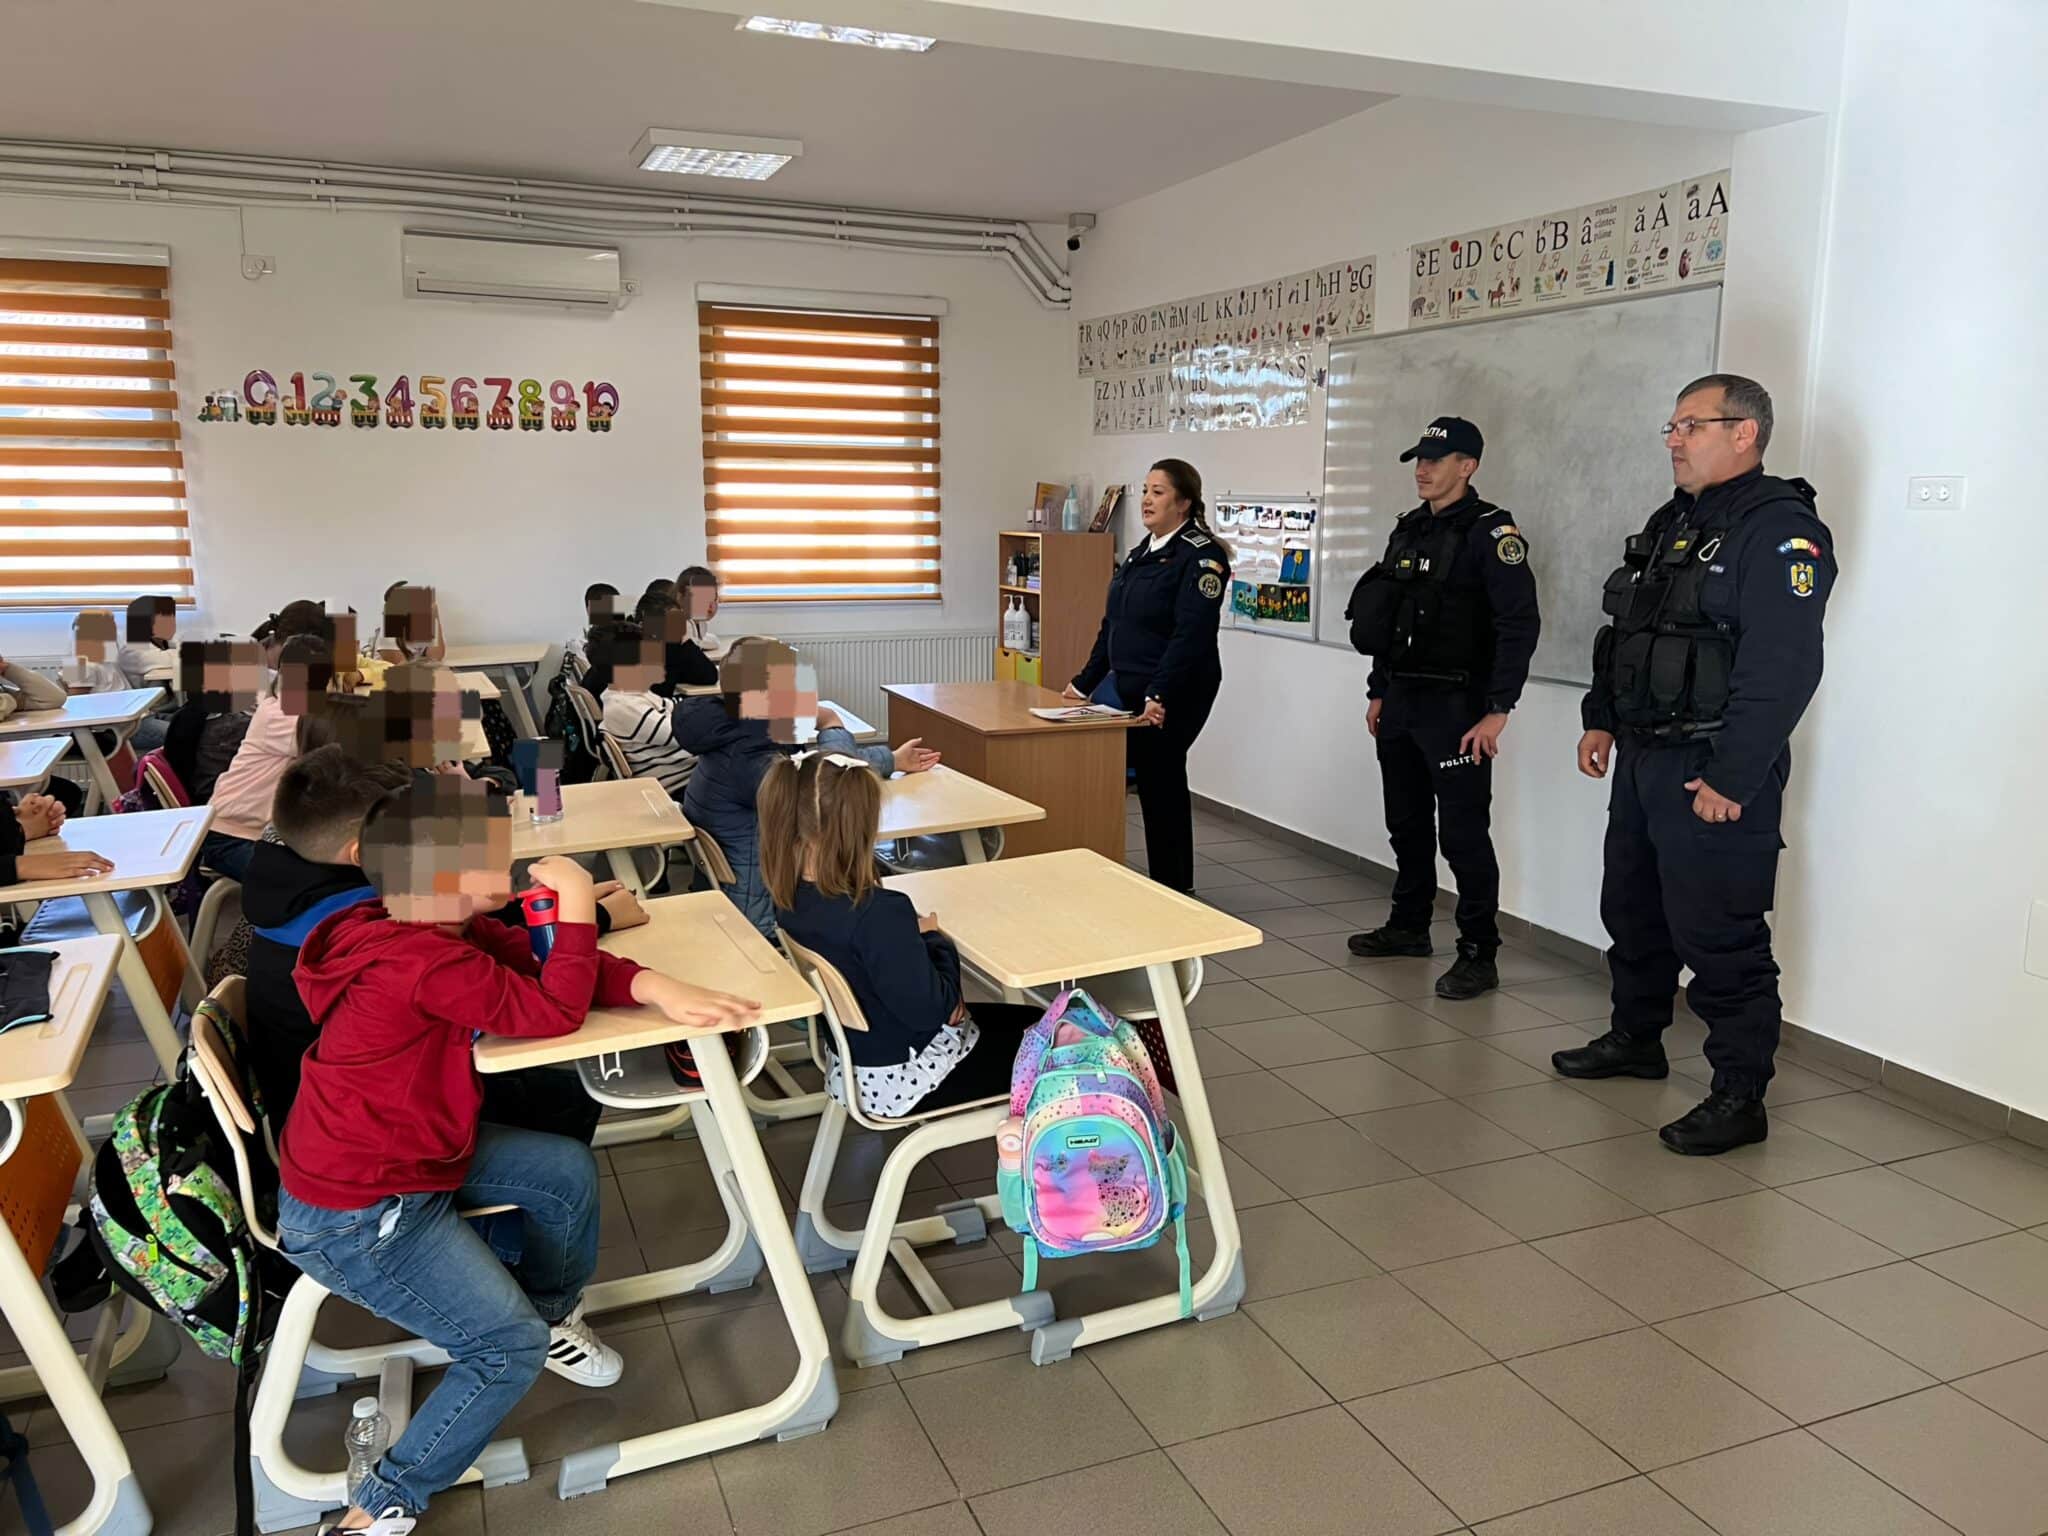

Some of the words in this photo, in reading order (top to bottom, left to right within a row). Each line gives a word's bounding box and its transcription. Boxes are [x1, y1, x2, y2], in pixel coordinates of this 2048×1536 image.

[290, 371, 306, 411] 1
[311, 371, 338, 411] 2
[349, 374, 380, 412] 3
[385, 375, 415, 414] 4
[419, 375, 445, 414] 5
[450, 376, 478, 414] 6
[483, 377, 513, 416] 7
[518, 378, 542, 417] 8
[549, 379, 577, 415] 9
